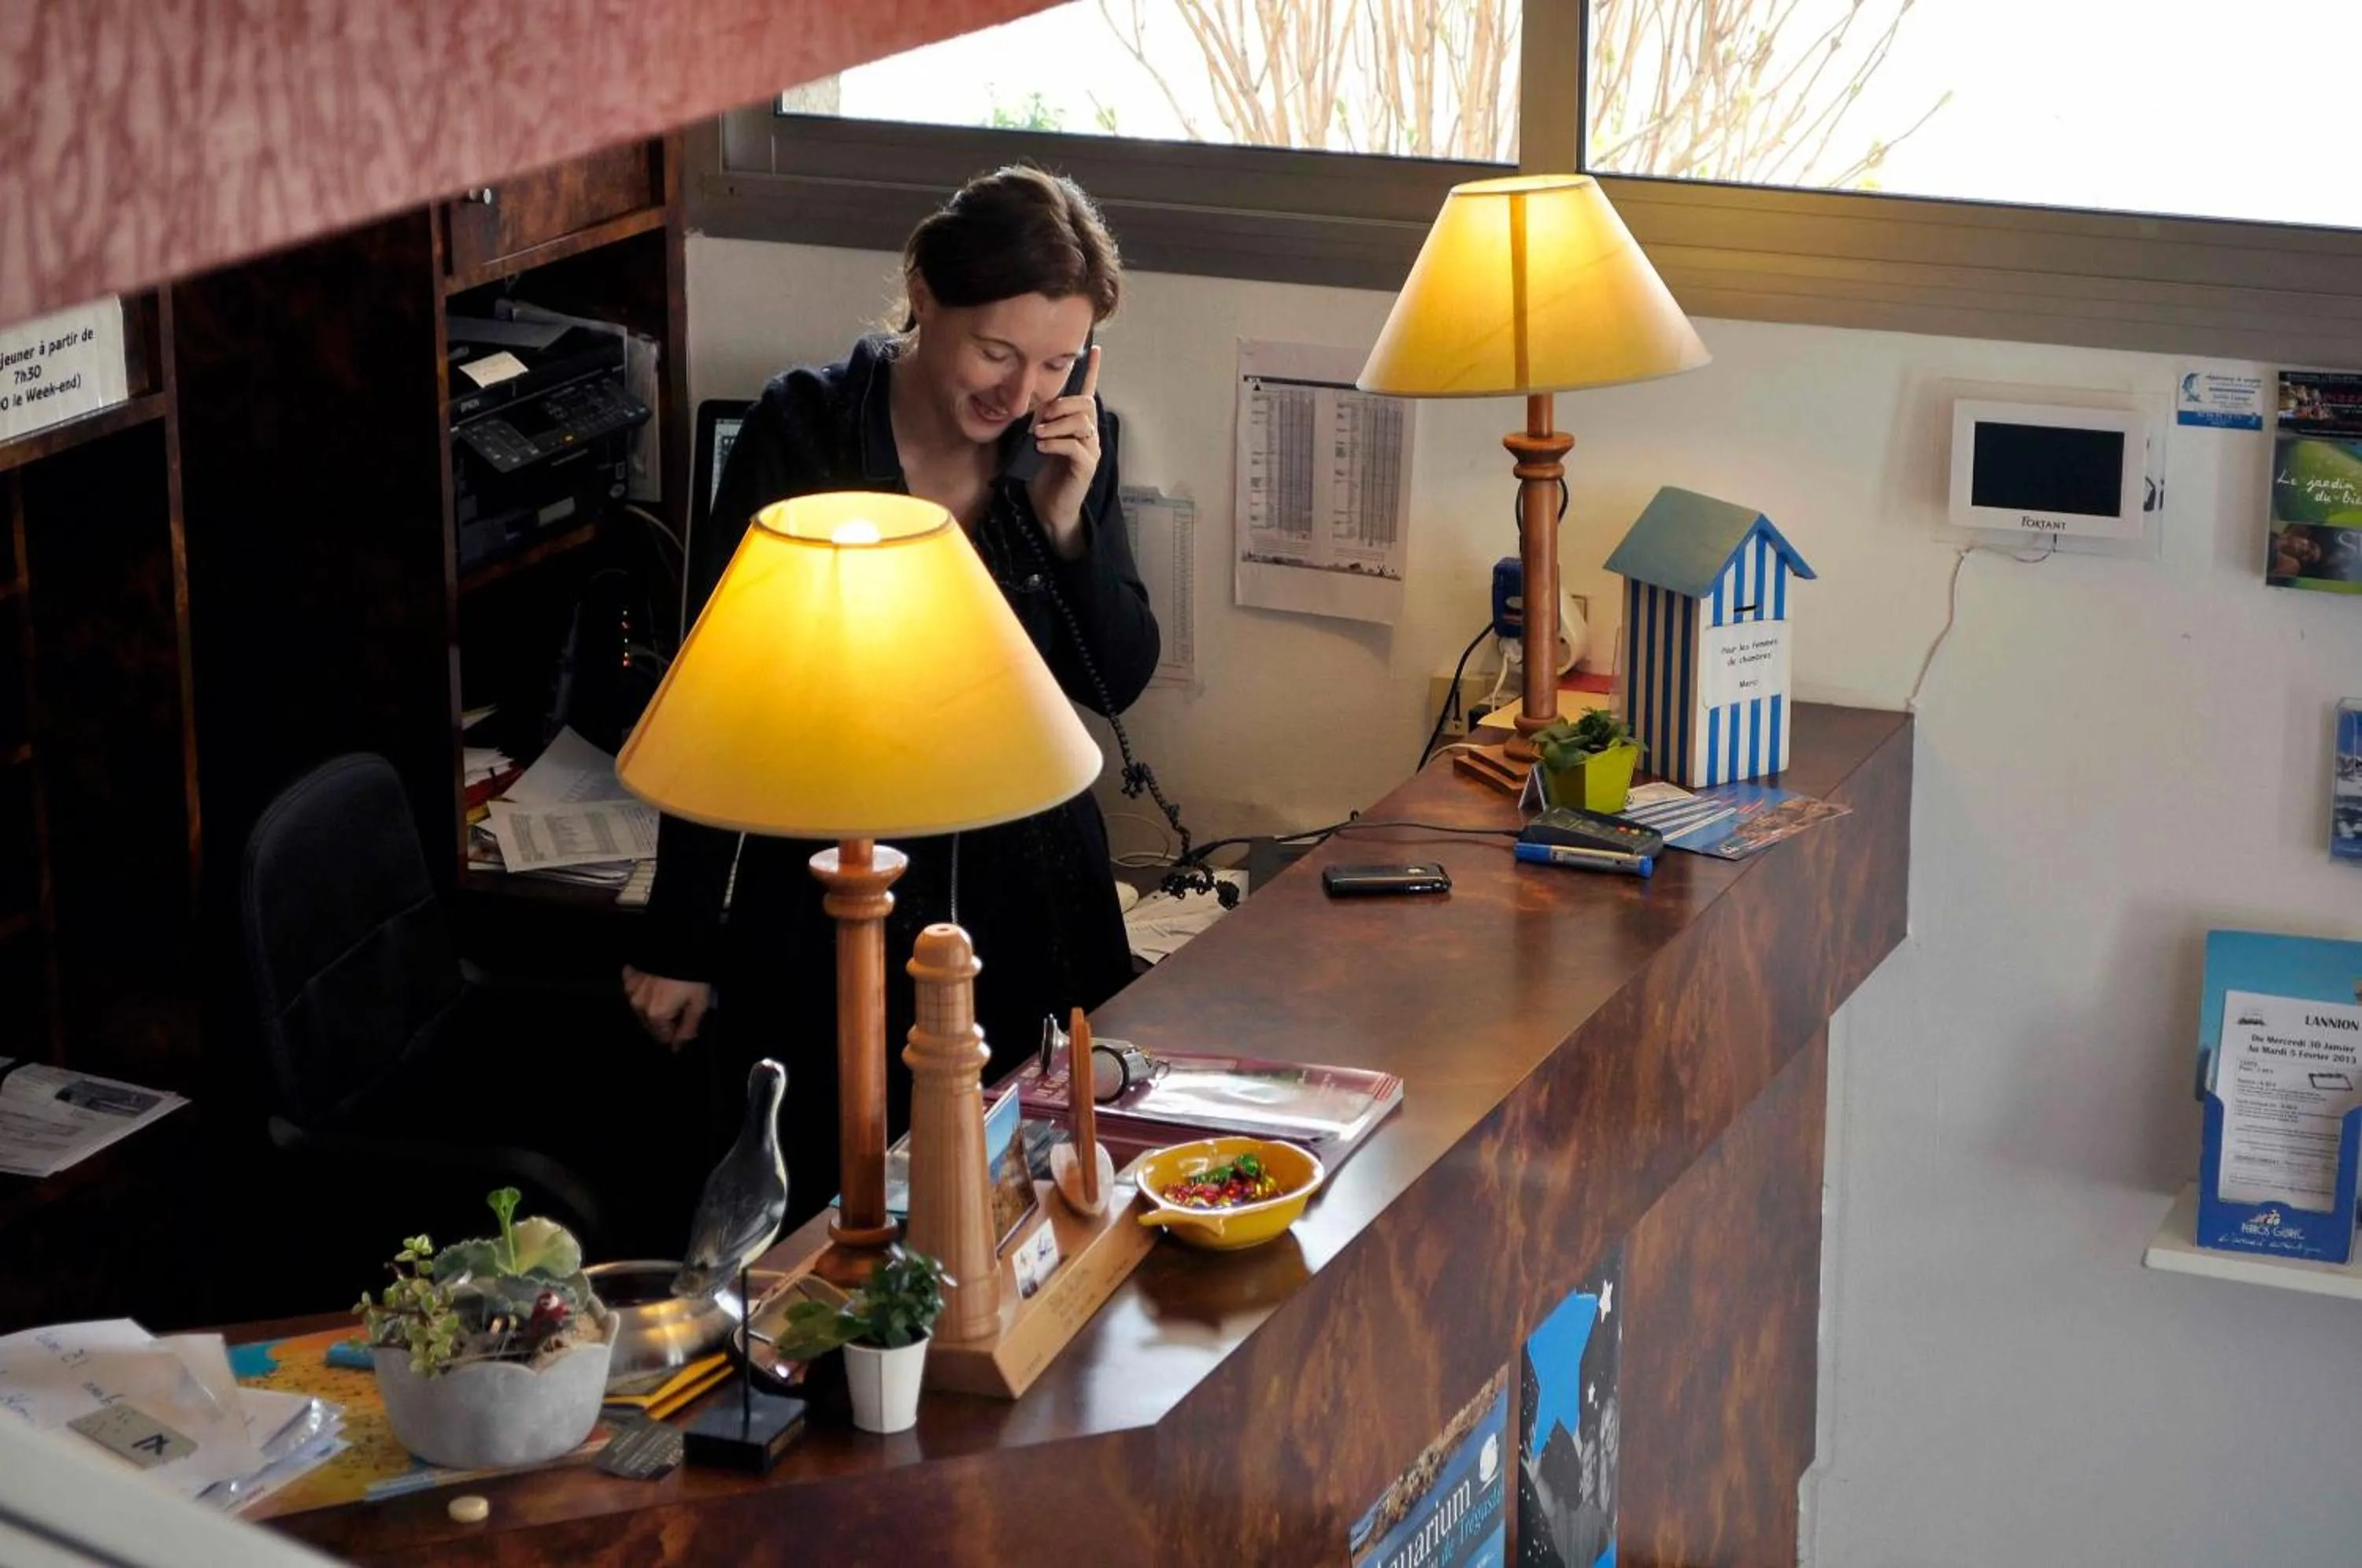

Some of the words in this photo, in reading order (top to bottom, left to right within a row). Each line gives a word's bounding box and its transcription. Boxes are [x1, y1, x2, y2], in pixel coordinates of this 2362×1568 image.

[0, 346, 35, 370] jeuner
[39, 340, 45, 356] à
[49, 332, 78, 356] partir
[81, 327, 94, 342] de
[14, 365, 42, 385] 7h30
[0, 396, 9, 411] 0
[13, 393, 23, 406] le
[26, 372, 82, 403] Week-end)
[2306, 475, 2356, 493] jardin
[2315, 490, 2331, 504] du
[2305, 1015, 2360, 1031] LANNION
[2252, 1034, 2264, 1042] Du
[2267, 1036, 2305, 1047] Mercredi
[2324, 1042, 2355, 1053] Janvier
[2262, 1046, 2286, 1056] Mardi
[1377, 1480, 1471, 1568] uarium
